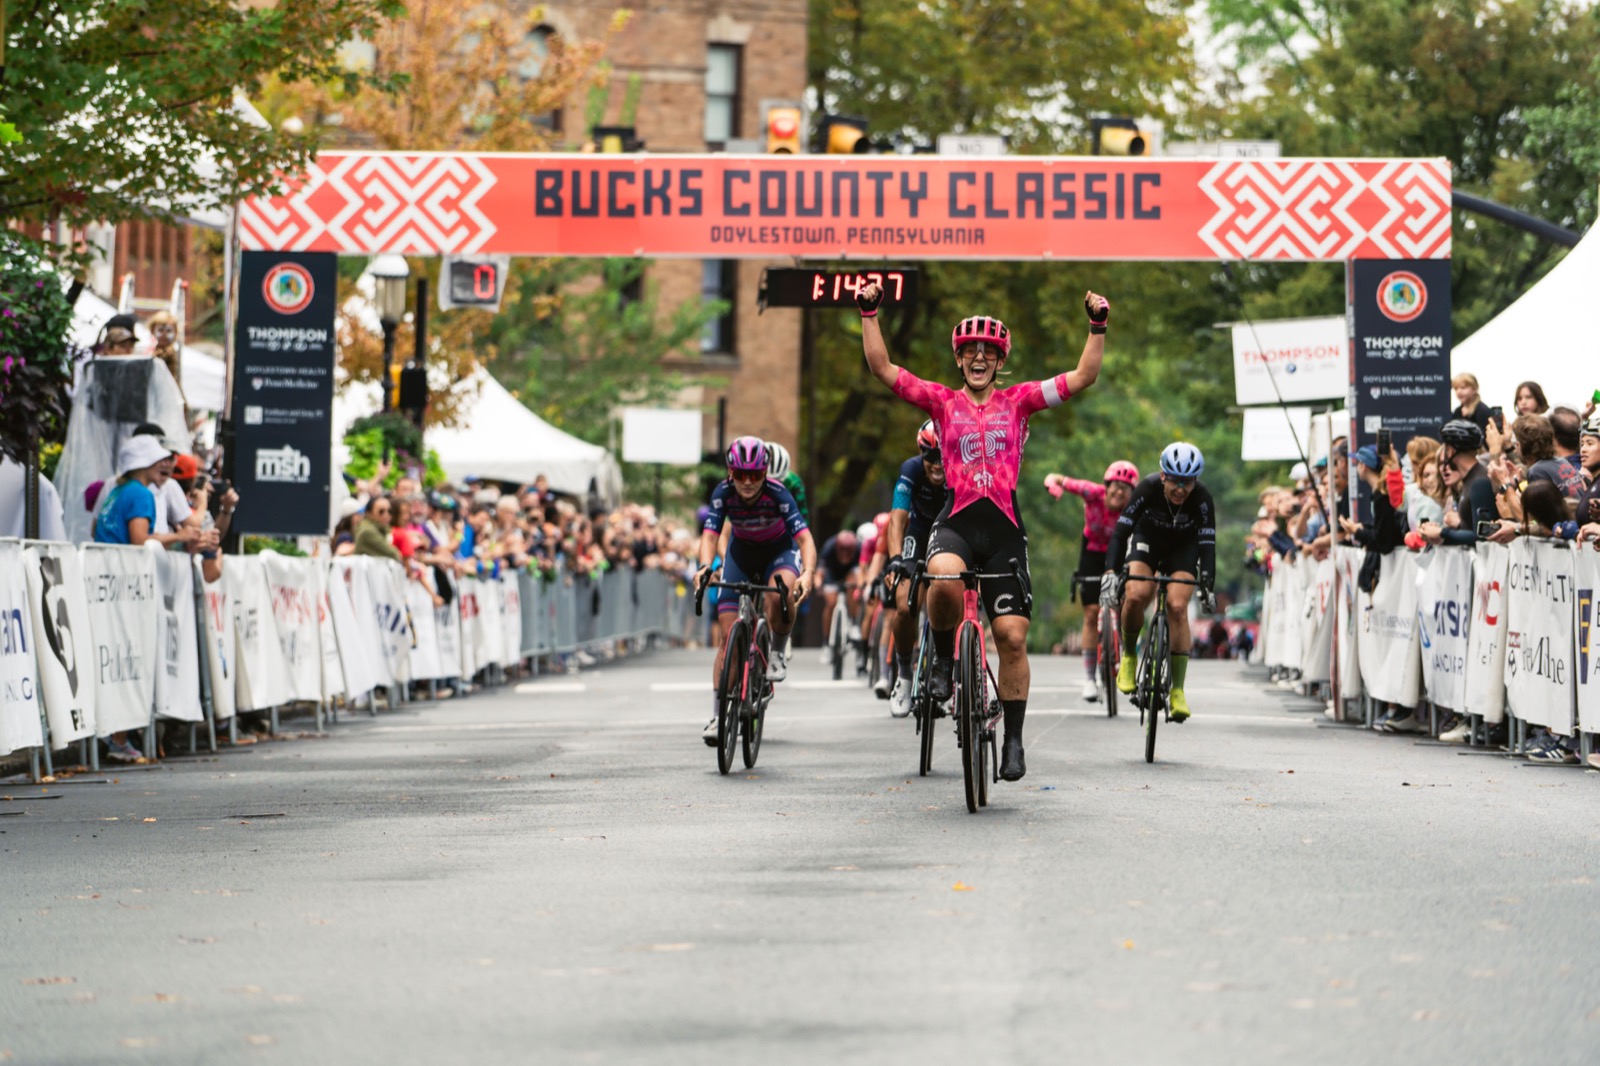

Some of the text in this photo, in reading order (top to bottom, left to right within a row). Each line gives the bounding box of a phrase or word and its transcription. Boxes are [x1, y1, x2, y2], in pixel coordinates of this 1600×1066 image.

[535, 169, 1161, 220] BUCKS COUNTY CLASSIC
[847, 227, 985, 245] PENNSYLVANIA
[473, 264, 496, 299] 0
[248, 327, 327, 342] THOMPSON
[1363, 336, 1443, 349] THOMPSON
[1243, 345, 1339, 364] THOMPSON
